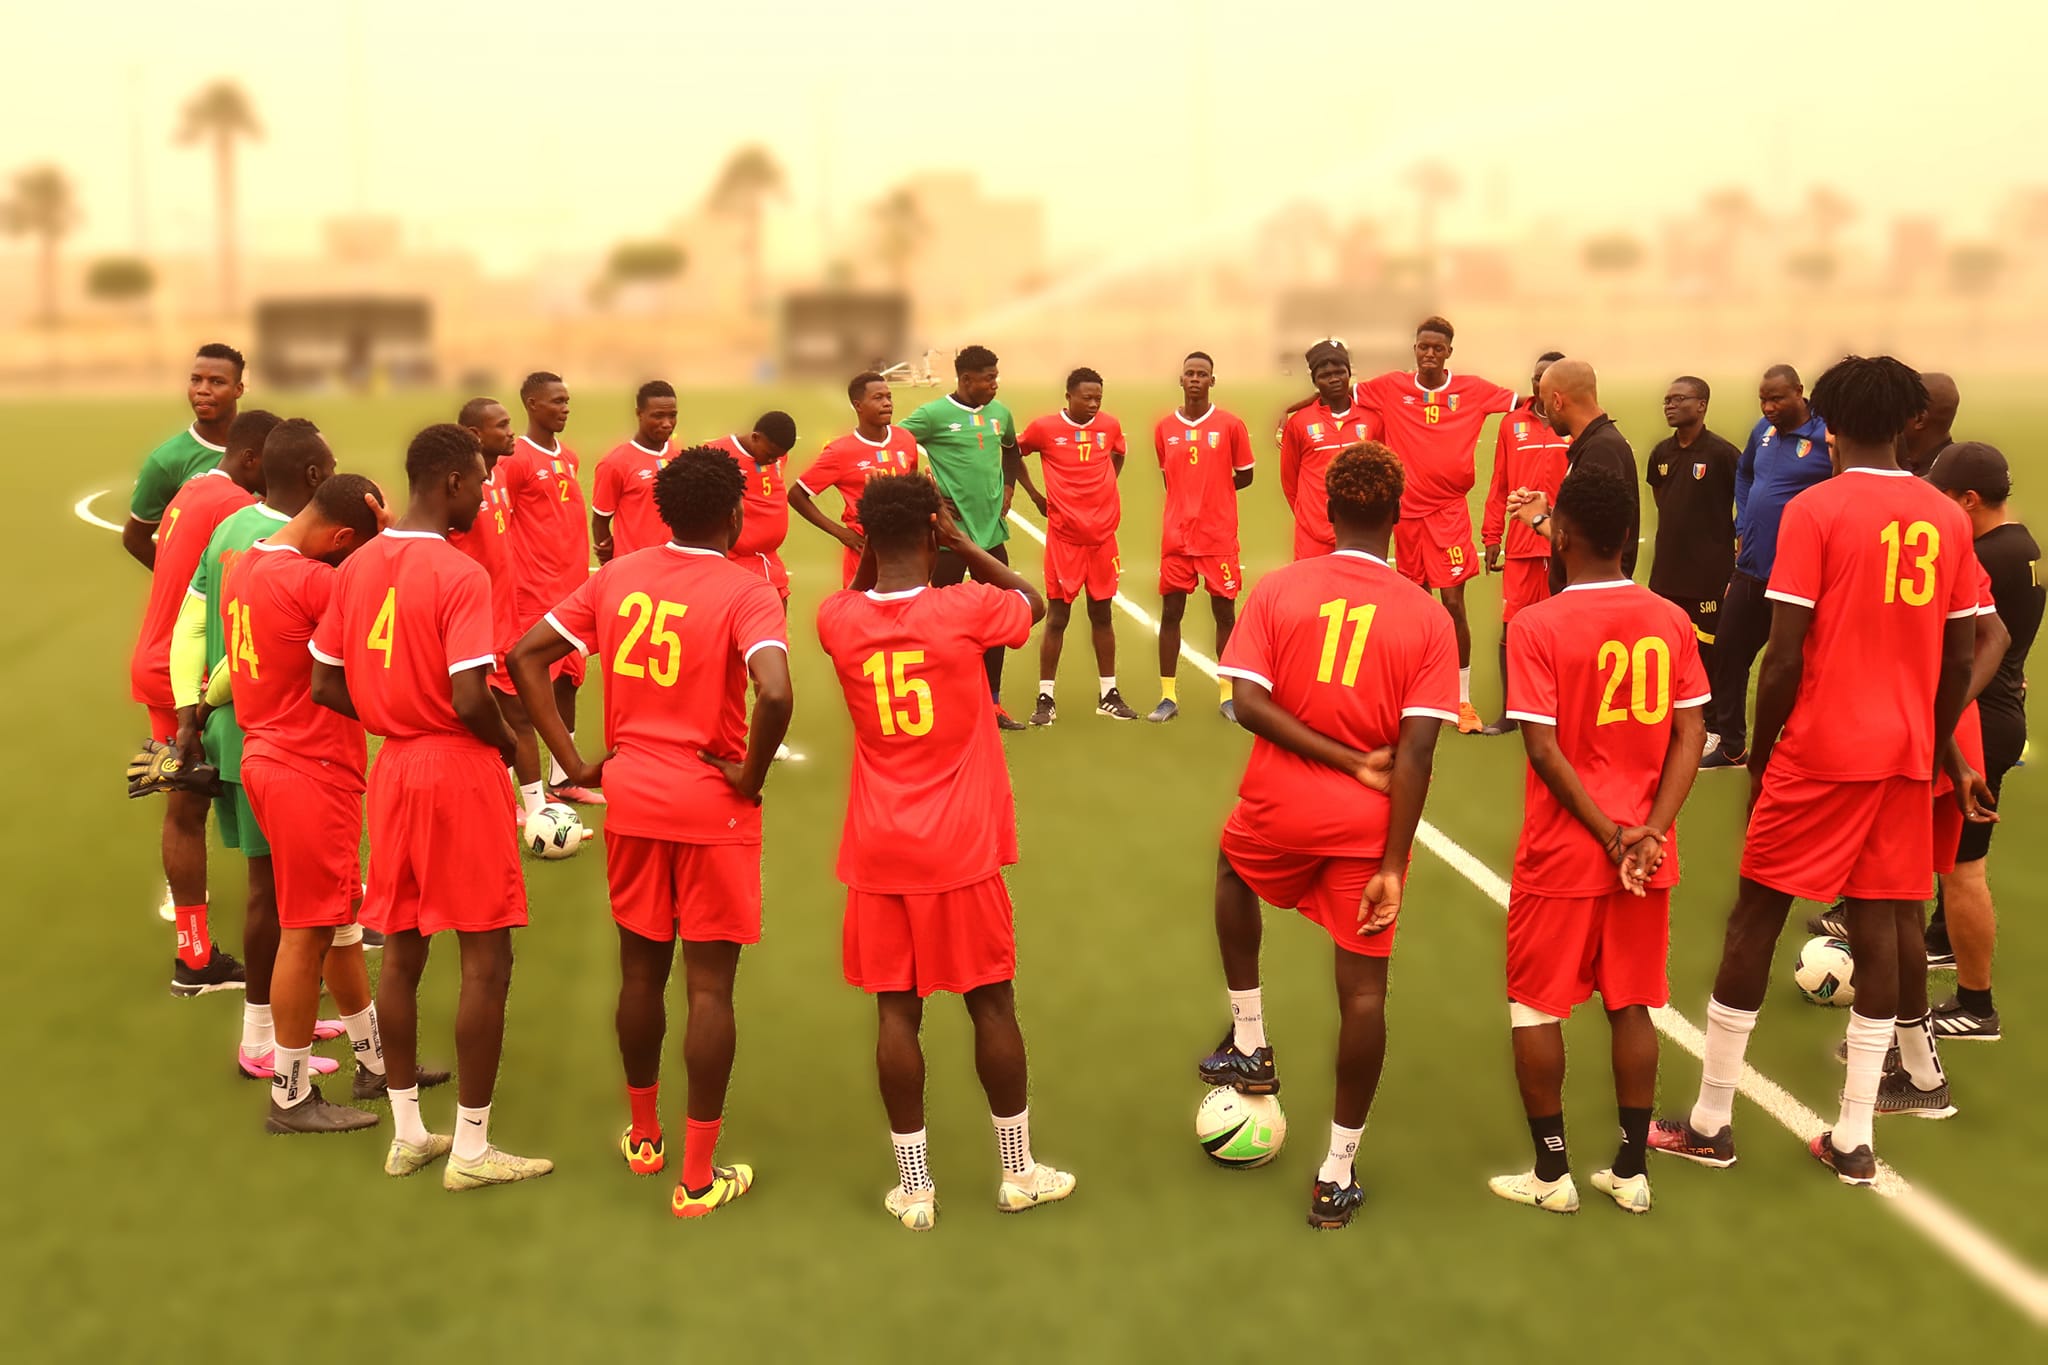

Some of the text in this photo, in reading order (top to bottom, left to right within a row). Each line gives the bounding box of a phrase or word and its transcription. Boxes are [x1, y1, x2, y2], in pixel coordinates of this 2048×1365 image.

[1423, 405, 1440, 424] 19
[1077, 443, 1091, 462] 17
[1189, 446, 1198, 465] 3
[559, 480, 569, 502] 2
[762, 476, 771, 496] 5
[1446, 546, 1464, 565] 19
[1880, 520, 1940, 607] 13
[1221, 563, 1231, 581] 3
[1700, 600, 1717, 613] SAO
[228, 597, 259, 680] 14
[367, 587, 396, 669] 4
[613, 591, 689, 687] 25
[1317, 598, 1377, 688] 11
[1596, 636, 1670, 726] 20
[862, 650, 934, 737] 15
